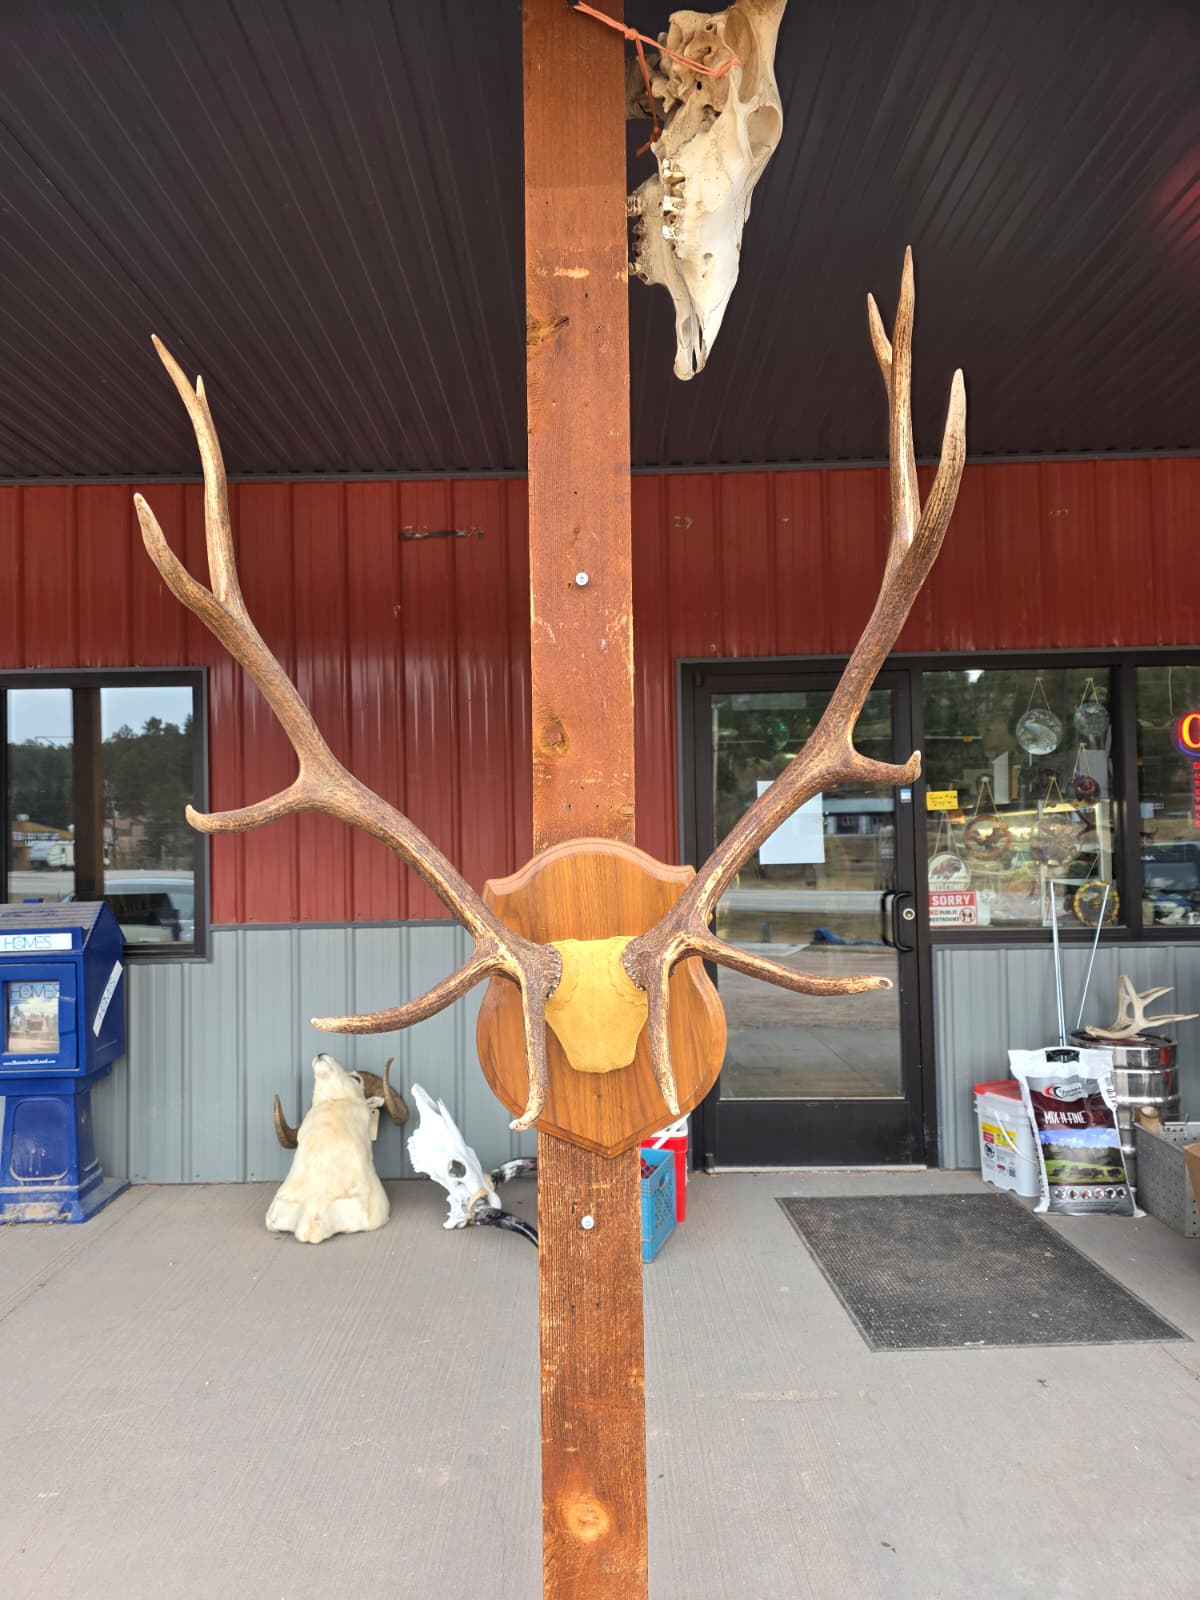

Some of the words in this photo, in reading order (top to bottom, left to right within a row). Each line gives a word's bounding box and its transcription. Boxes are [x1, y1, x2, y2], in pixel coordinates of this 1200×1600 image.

[931, 894, 971, 906] SORRY
[4, 935, 52, 950] HOMES
[1043, 1110, 1087, 1125] MIX-N-FINE
